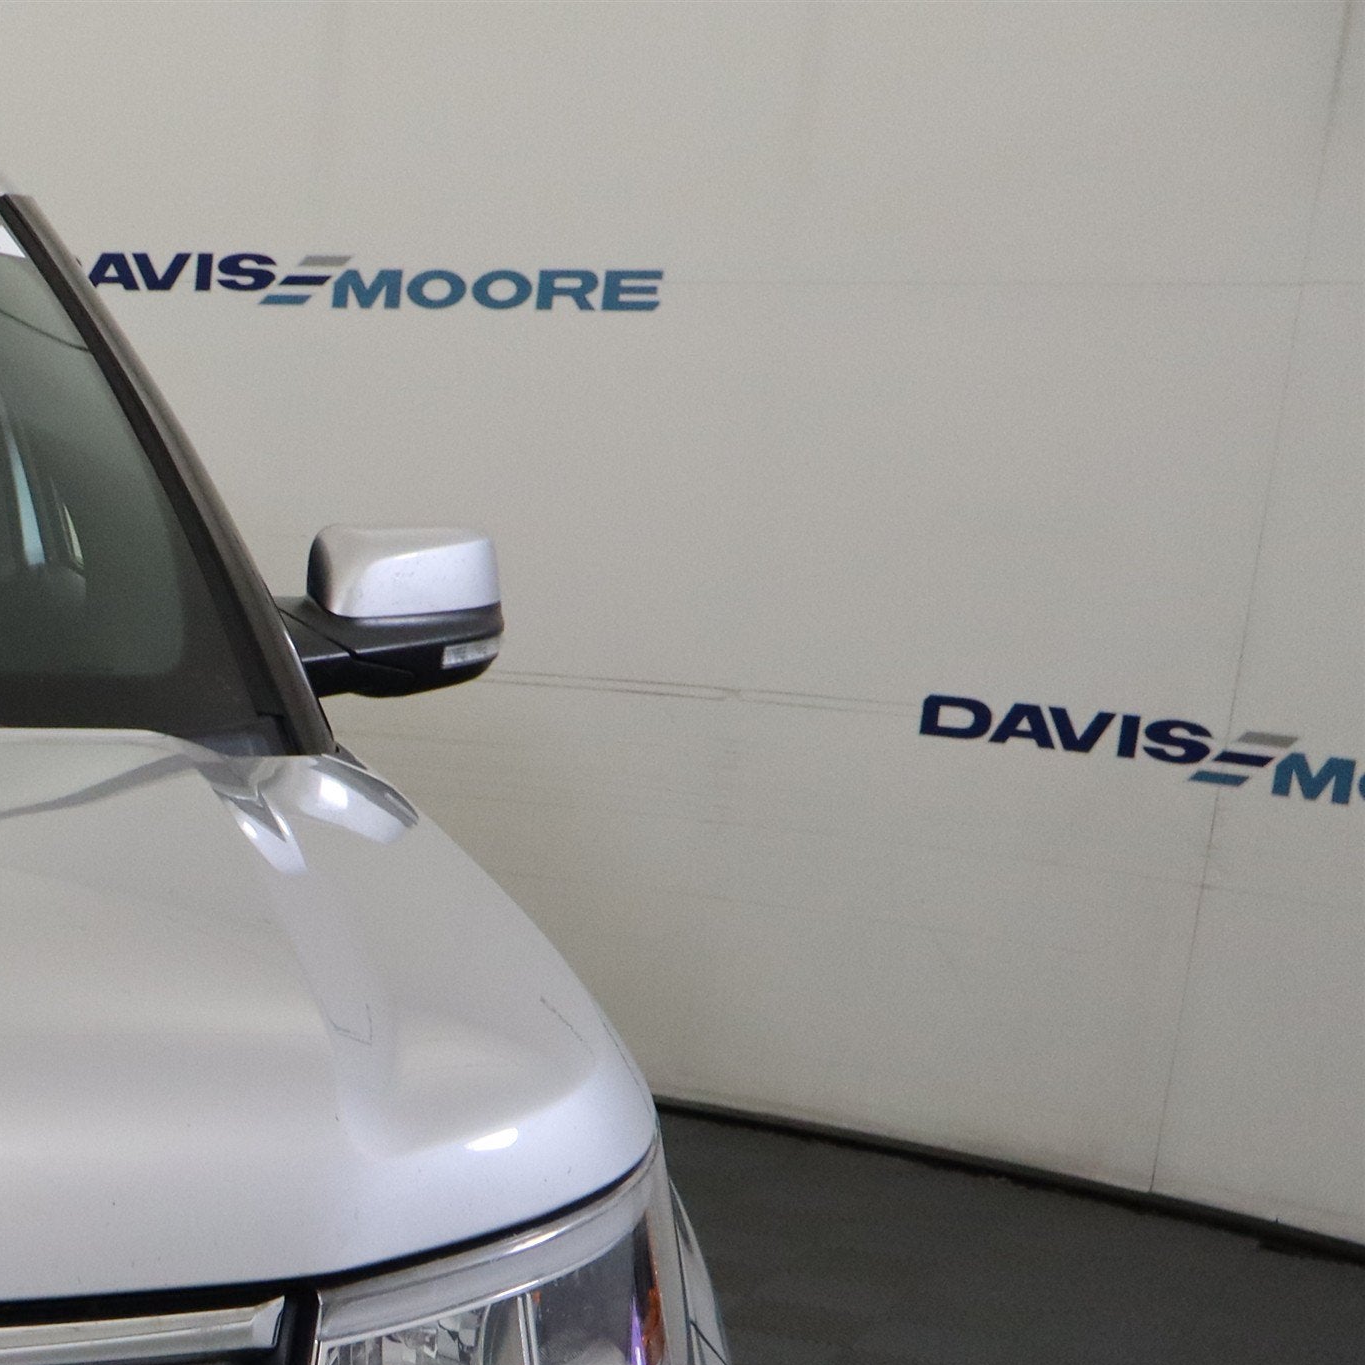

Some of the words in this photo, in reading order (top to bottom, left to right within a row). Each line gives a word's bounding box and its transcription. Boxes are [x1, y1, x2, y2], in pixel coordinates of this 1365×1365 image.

[88, 252, 276, 291] AVIS
[330, 268, 664, 312] MOORE
[919, 693, 1214, 765] DAVIS
[1270, 752, 1365, 805] M
